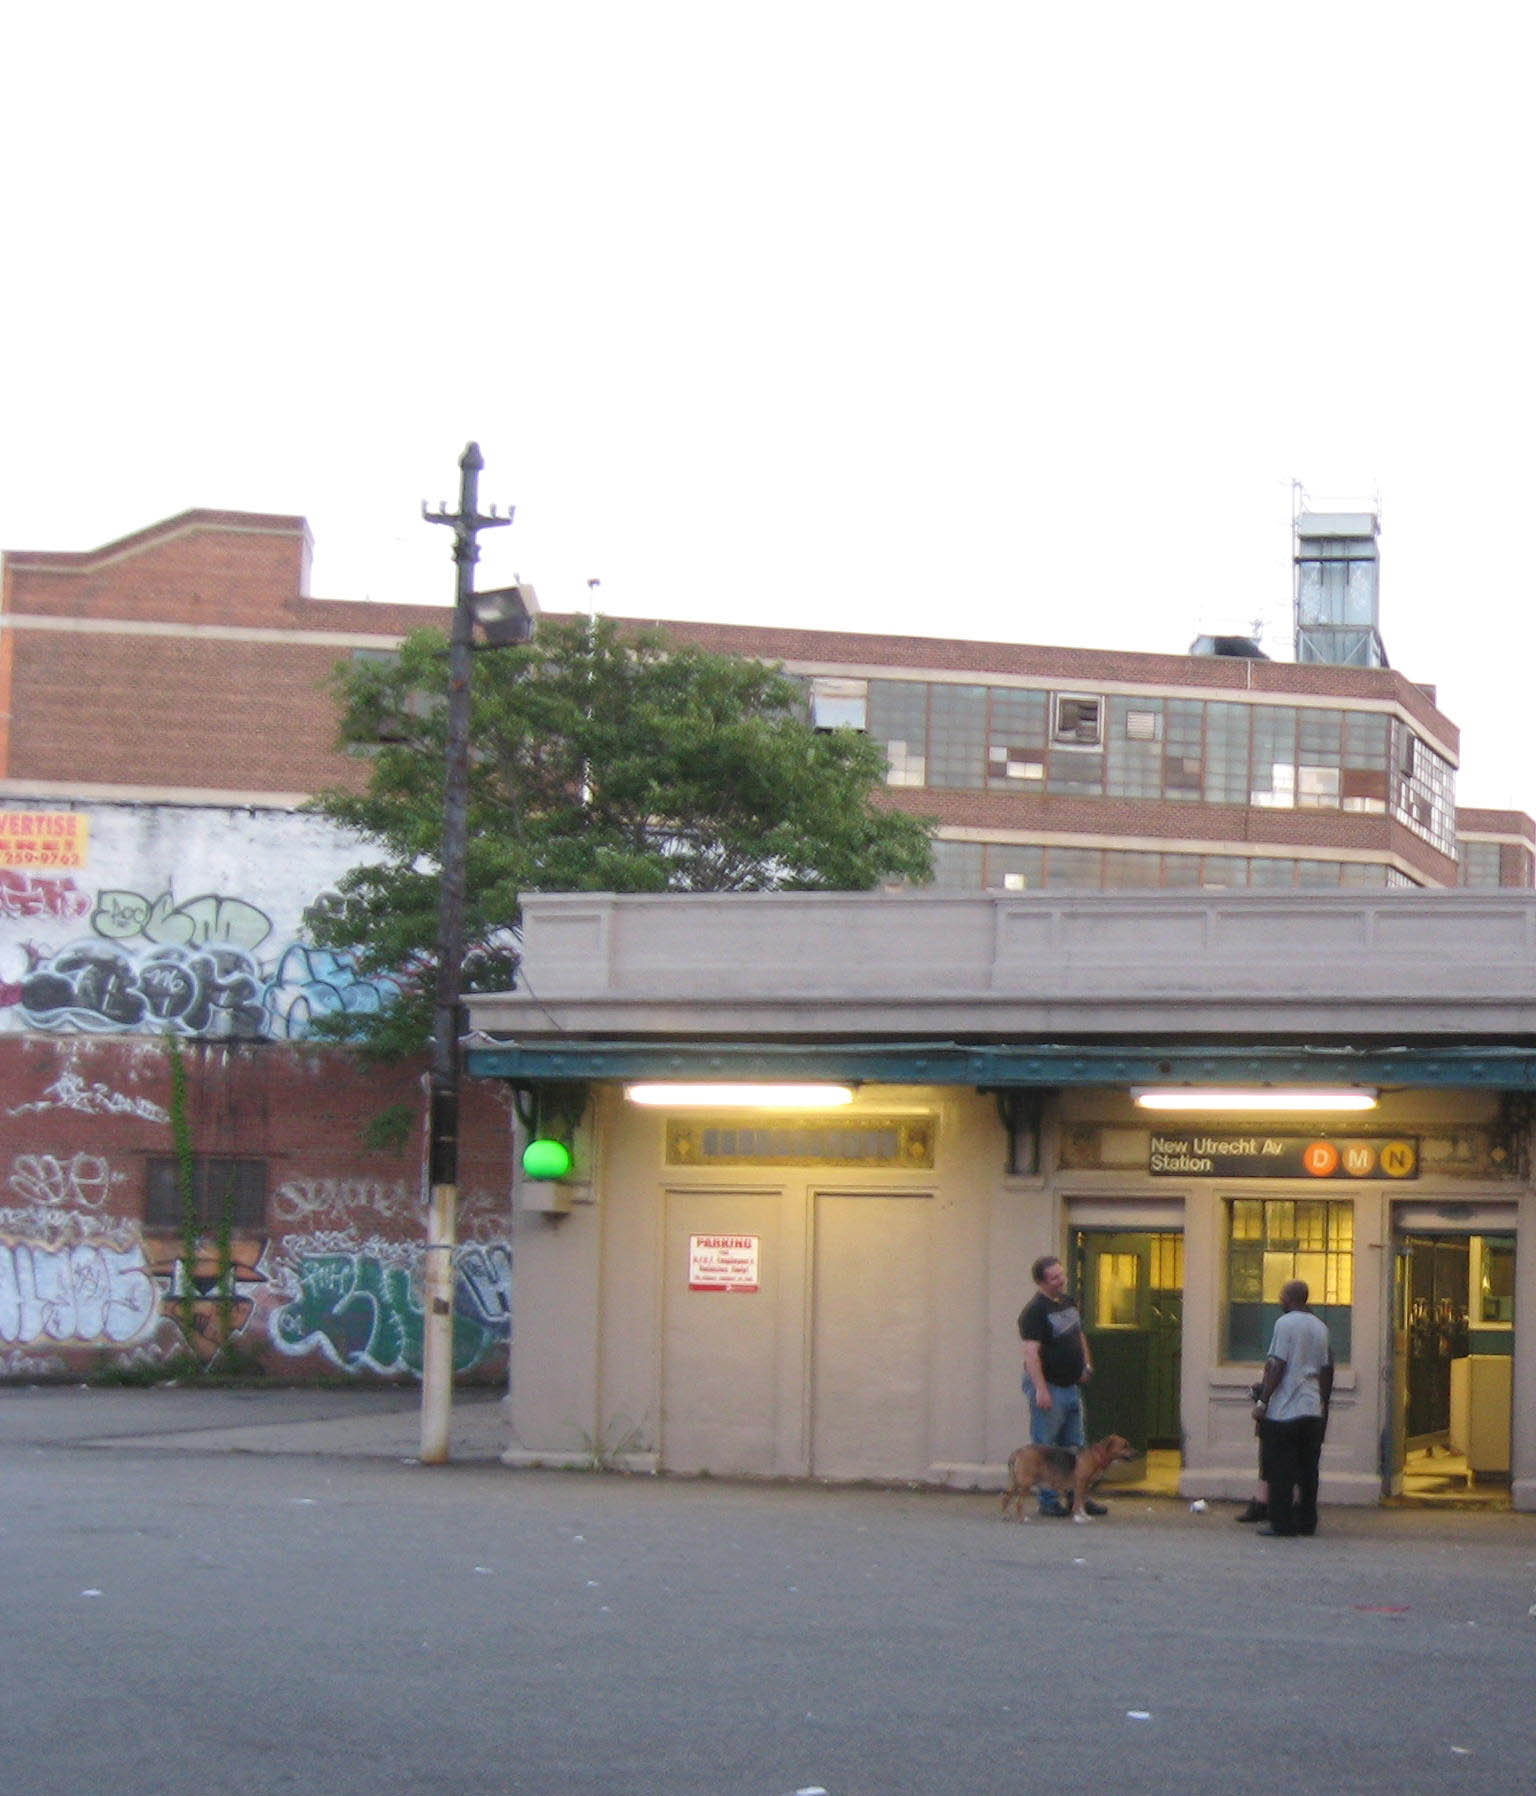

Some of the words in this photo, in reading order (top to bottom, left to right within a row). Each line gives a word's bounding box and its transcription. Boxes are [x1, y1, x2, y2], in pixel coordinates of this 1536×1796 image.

[1152, 1138, 1188, 1153] New
[1193, 1138, 1256, 1154] Utrecht
[1262, 1139, 1283, 1156] Av
[1151, 1155, 1212, 1172] Station
[1313, 1150, 1329, 1167] D
[1350, 1150, 1368, 1167] M
[1388, 1150, 1406, 1168] N
[696, 1237, 753, 1249] PARKING
